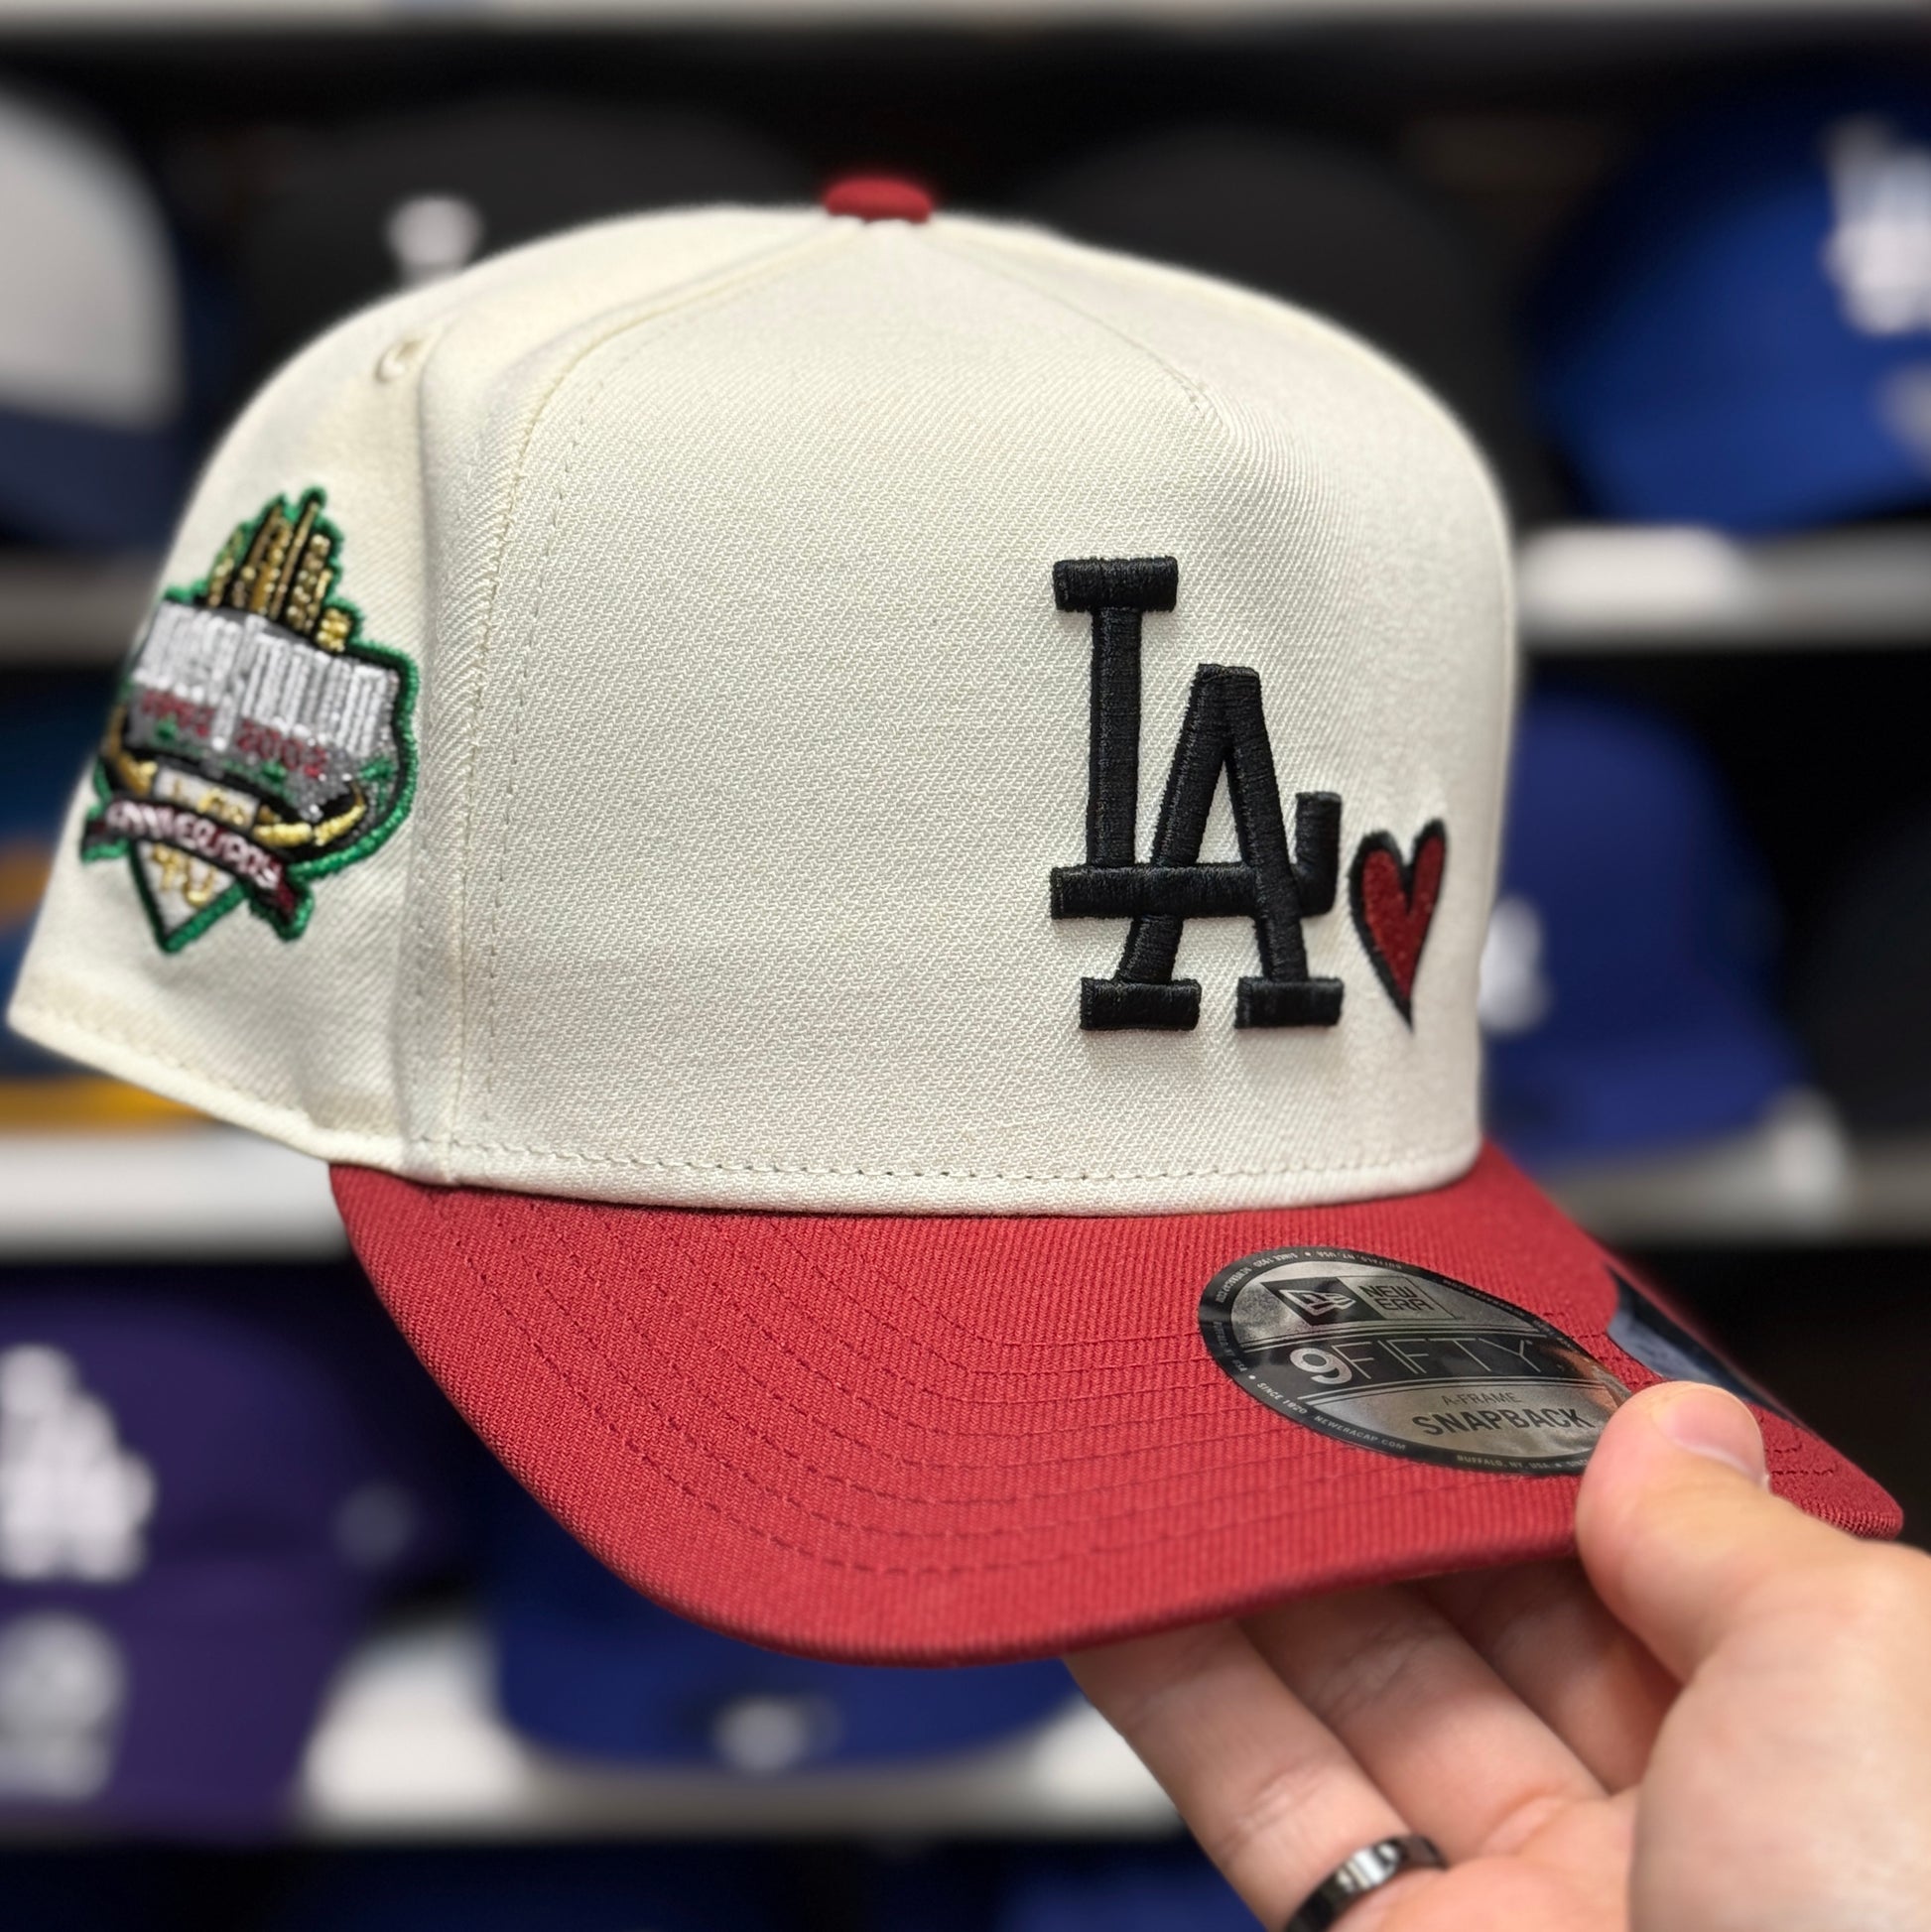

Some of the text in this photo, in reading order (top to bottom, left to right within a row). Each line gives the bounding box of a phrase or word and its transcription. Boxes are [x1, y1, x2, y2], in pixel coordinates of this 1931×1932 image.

[1050, 556, 1344, 1030] LA
[1358, 1285, 1418, 1298] NEW
[1373, 1298, 1436, 1311] ERA
[1289, 1337, 1542, 1385] 9FIFTY
[1442, 1391, 1523, 1407] A-FRAME
[1256, 1381, 1284, 1401] SINCE
[1283, 1398, 1308, 1415] 1920
[1313, 1414, 1407, 1451] NEWERACAP.COM
[1411, 1407, 1597, 1436] SNAPBACK
